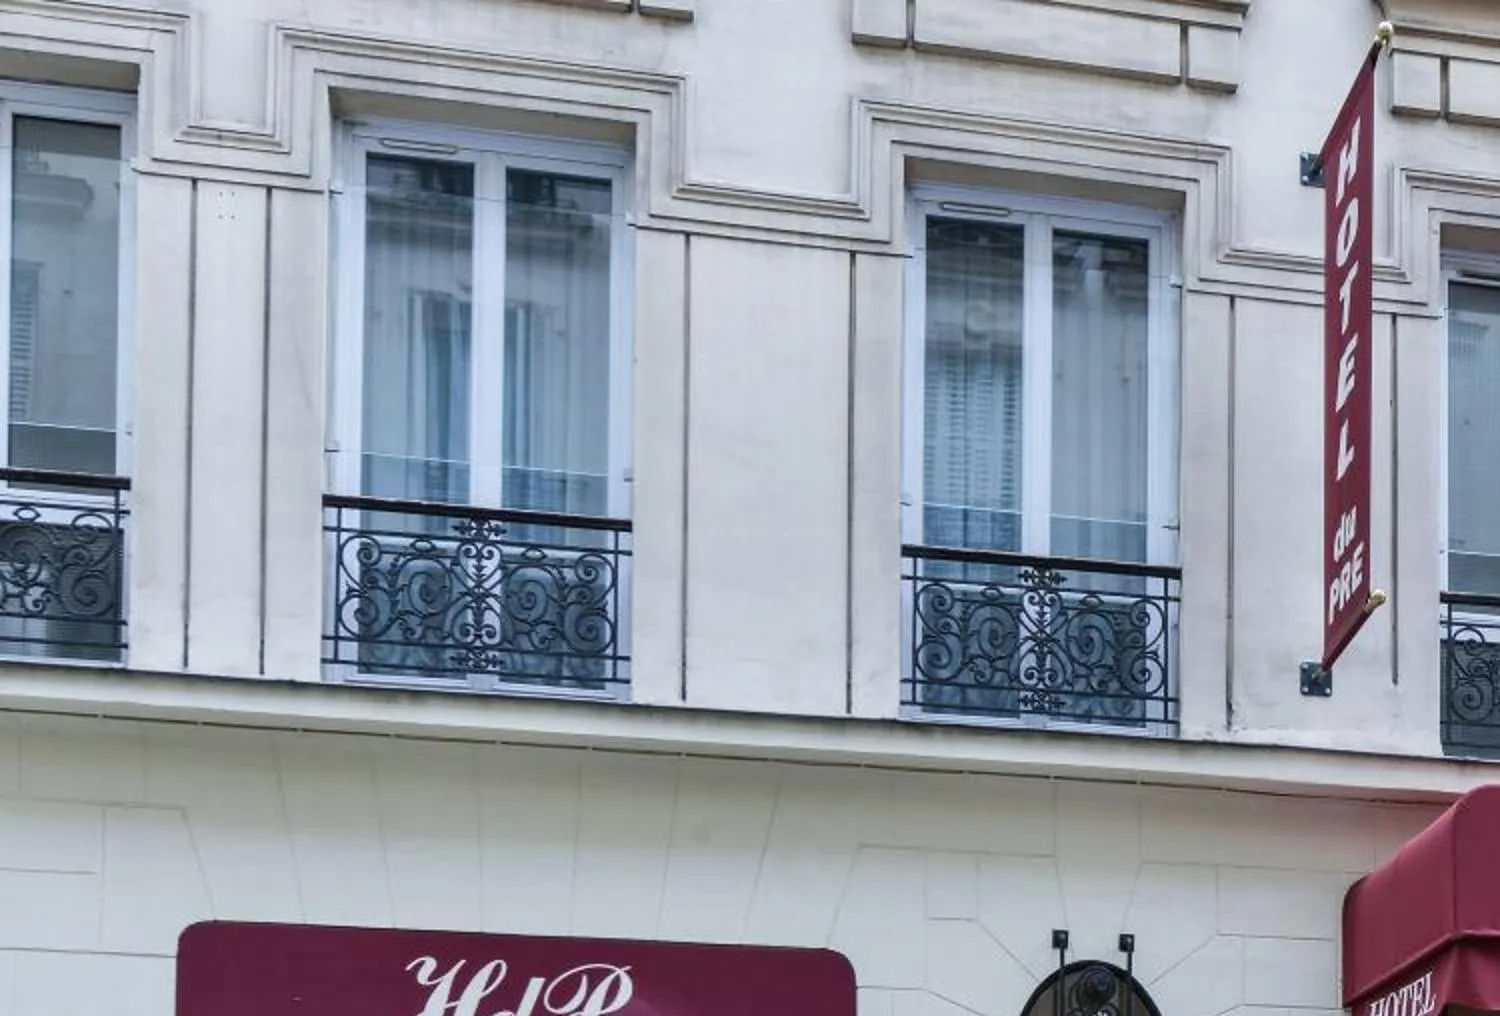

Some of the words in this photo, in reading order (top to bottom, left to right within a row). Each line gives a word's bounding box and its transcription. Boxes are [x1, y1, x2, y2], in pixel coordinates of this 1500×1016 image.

[1335, 116, 1361, 482] HOTEL
[1333, 505, 1358, 562] du
[1328, 540, 1365, 625] PRE
